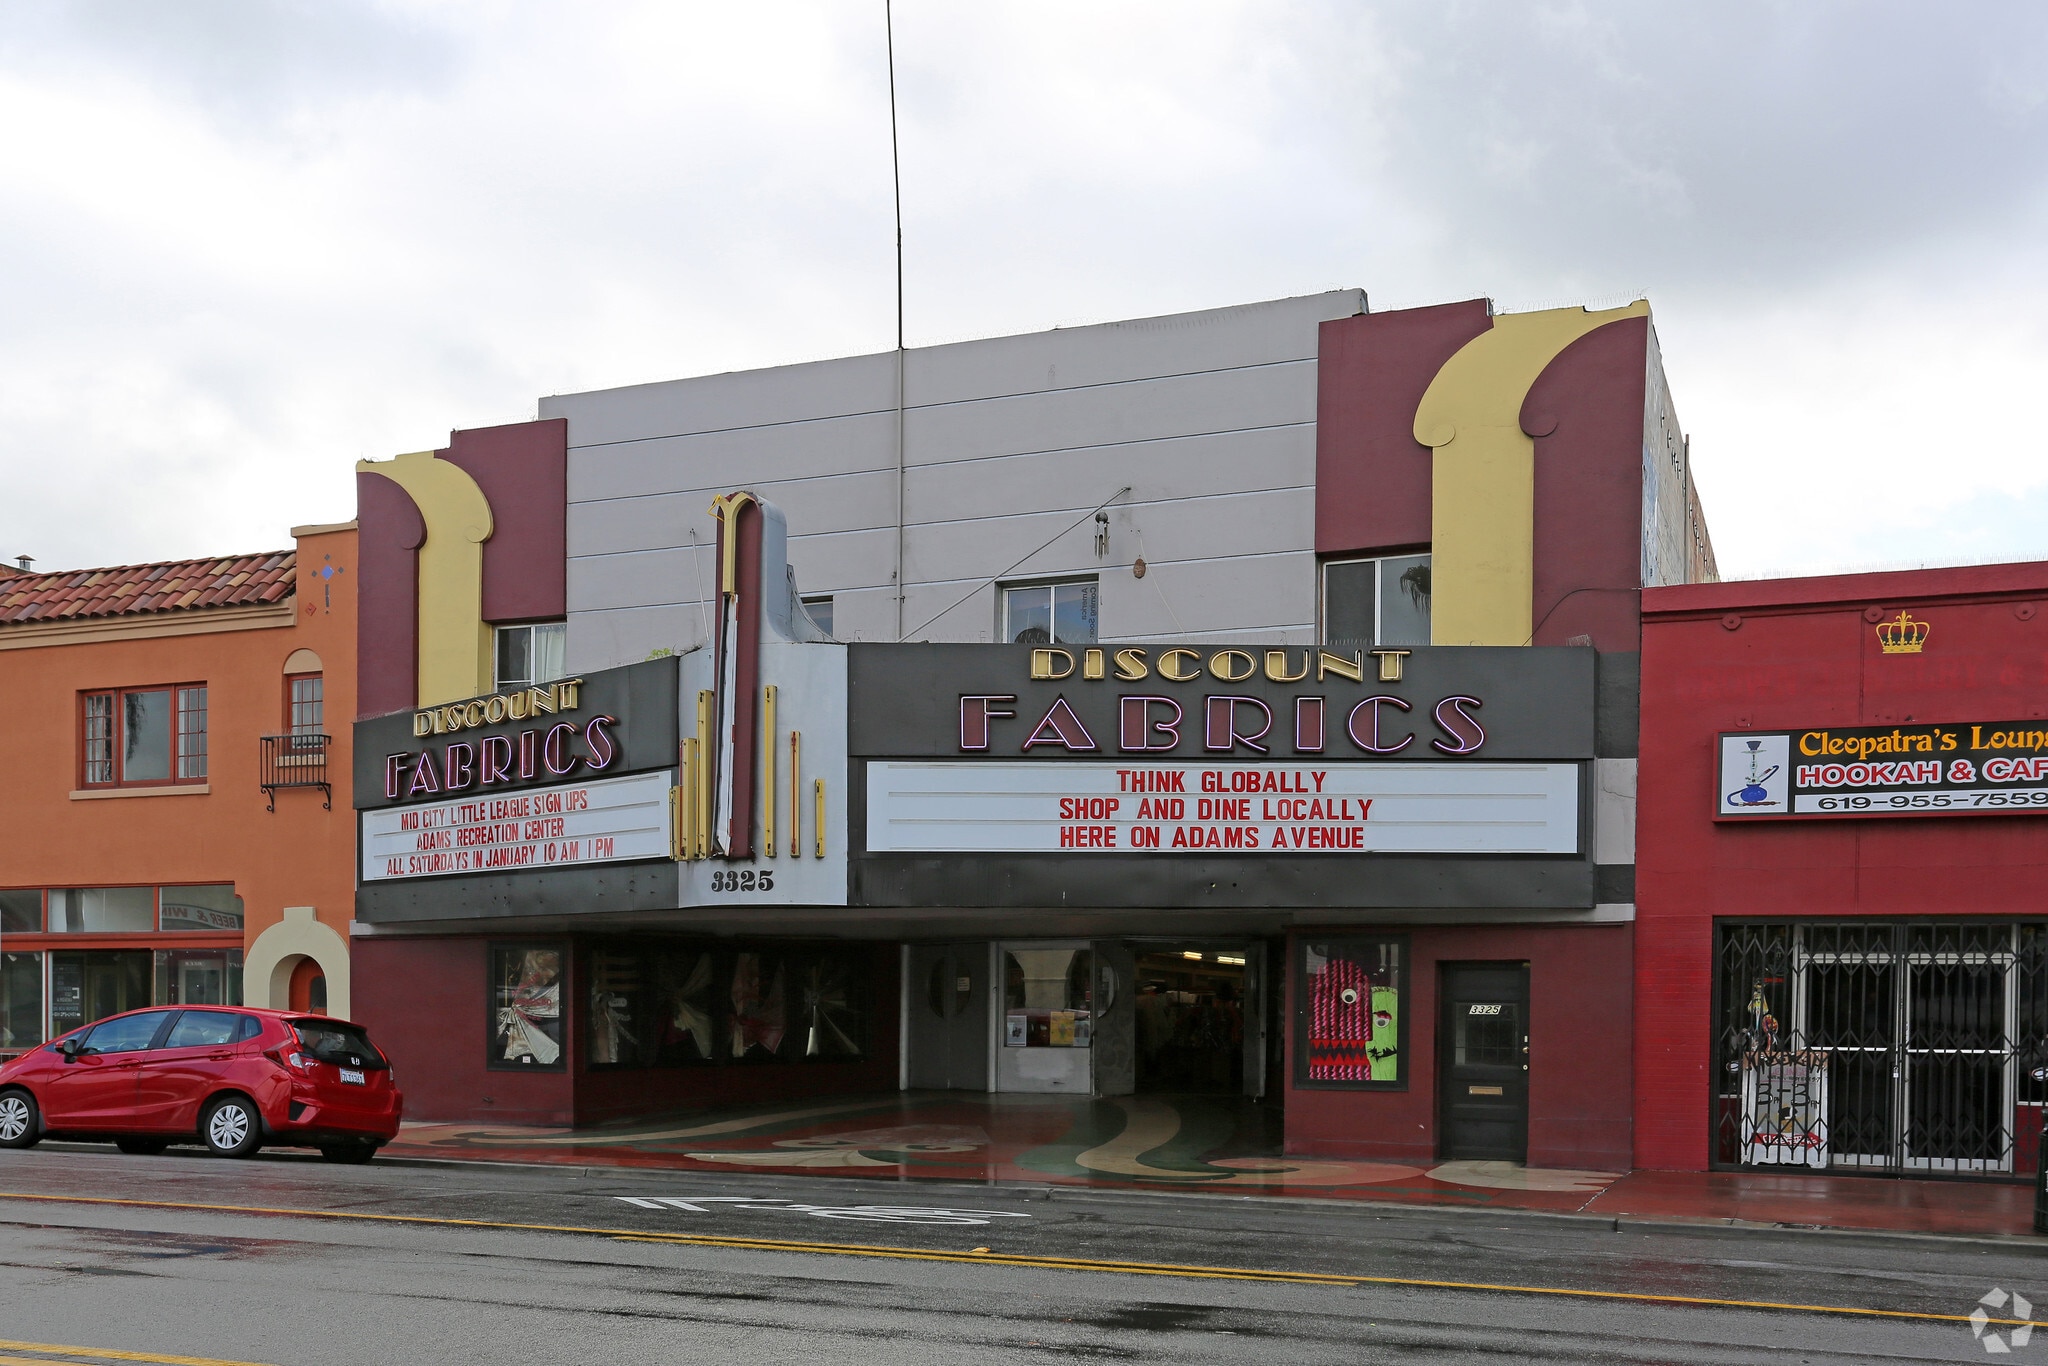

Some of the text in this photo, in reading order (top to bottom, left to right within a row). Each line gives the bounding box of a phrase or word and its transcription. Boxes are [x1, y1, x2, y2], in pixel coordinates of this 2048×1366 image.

[1030, 648, 1412, 683] DISCOUNT
[413, 679, 583, 737] DISCOUNT
[959, 693, 1486, 755] FABRICS
[385, 714, 619, 798] FABRICS
[1799, 726, 2048, 760] Cleopatra's Loun
[1117, 770, 1326, 793] THINK GLOBALLY
[1798, 762, 1939, 786] HOOKAH
[1950, 761, 1973, 781] &
[401, 789, 588, 831] MID CITY LITTLE LEAGUE SIGN UPS
[1060, 798, 1373, 821] SHOP AND DINE LOCALLY
[1818, 791, 2048, 810] 619-955-7559
[417, 817, 564, 851] ADAMS RECREATION CENTER
[1060, 826, 1364, 849] HERE ON ADAMS AVENUE
[387, 858, 404, 876] ALL
[409, 852, 468, 874] SATURDAYS
[472, 850, 483, 868] IN
[486, 845, 536, 867] JANUARY
[543, 843, 556, 861] 10
[560, 841, 579, 861] AM
[595, 837, 614, 857] PM
[711, 870, 774, 892] 3325
[1471, 1005, 1500, 1014] 3325
